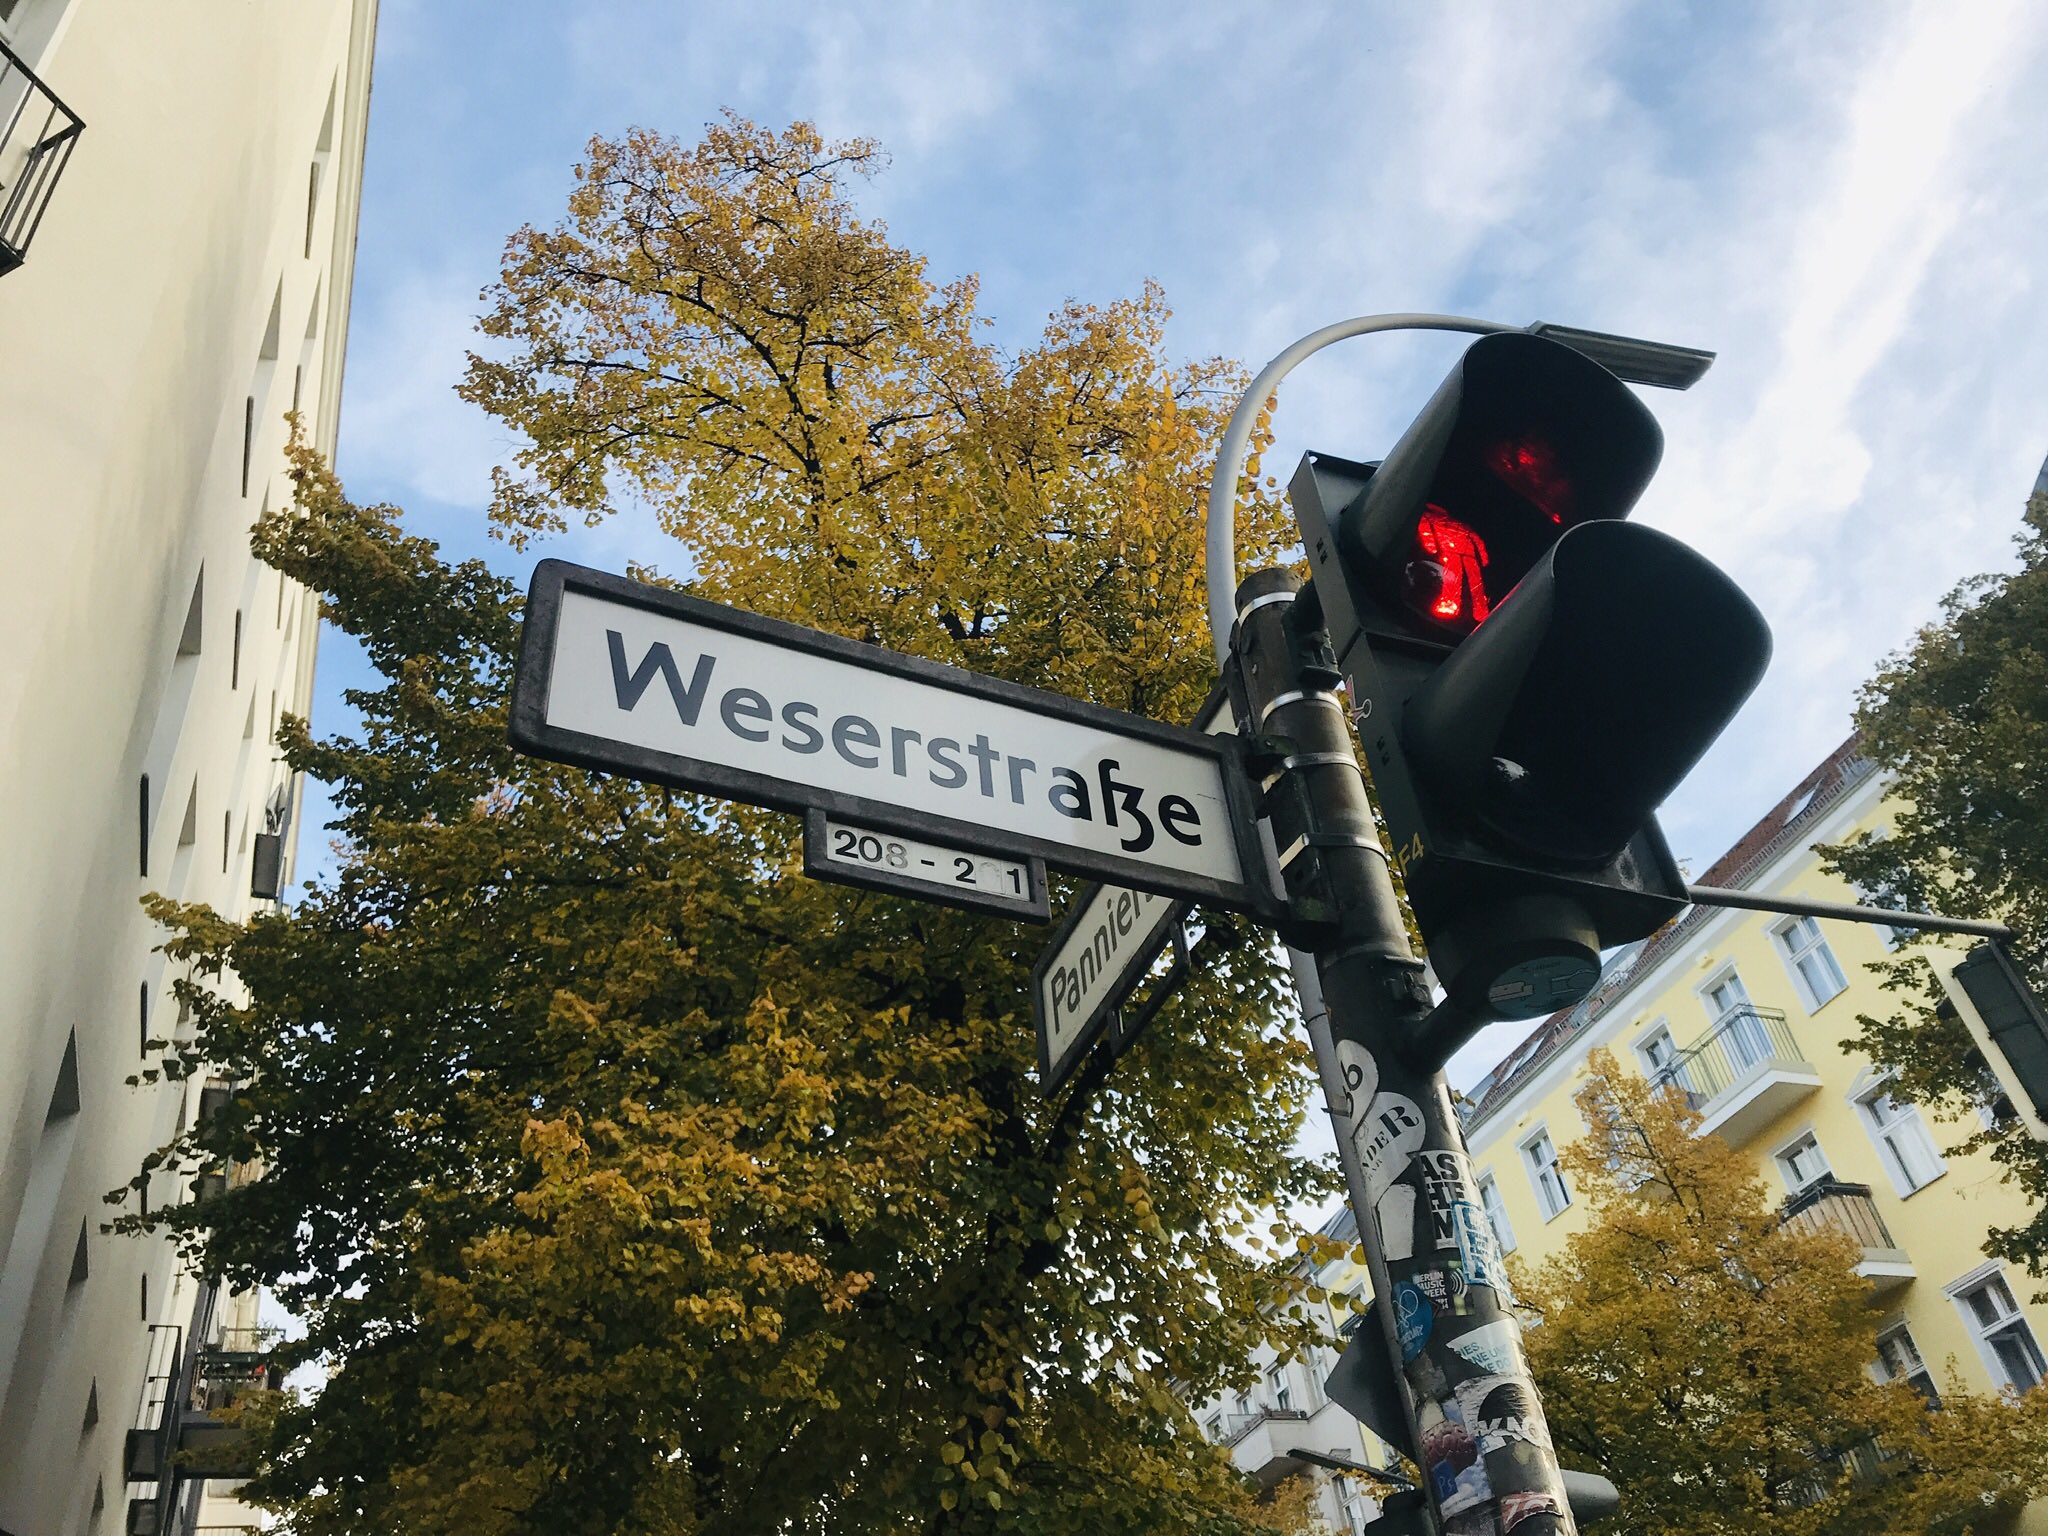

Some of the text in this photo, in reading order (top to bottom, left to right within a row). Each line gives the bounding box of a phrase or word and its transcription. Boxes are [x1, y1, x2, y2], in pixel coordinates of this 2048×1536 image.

[606, 629, 1202, 852] Weserstraße
[835, 829, 908, 869] 208
[1051, 889, 1154, 1034] Pannier
[1417, 1280, 1446, 1290] MUSIC
